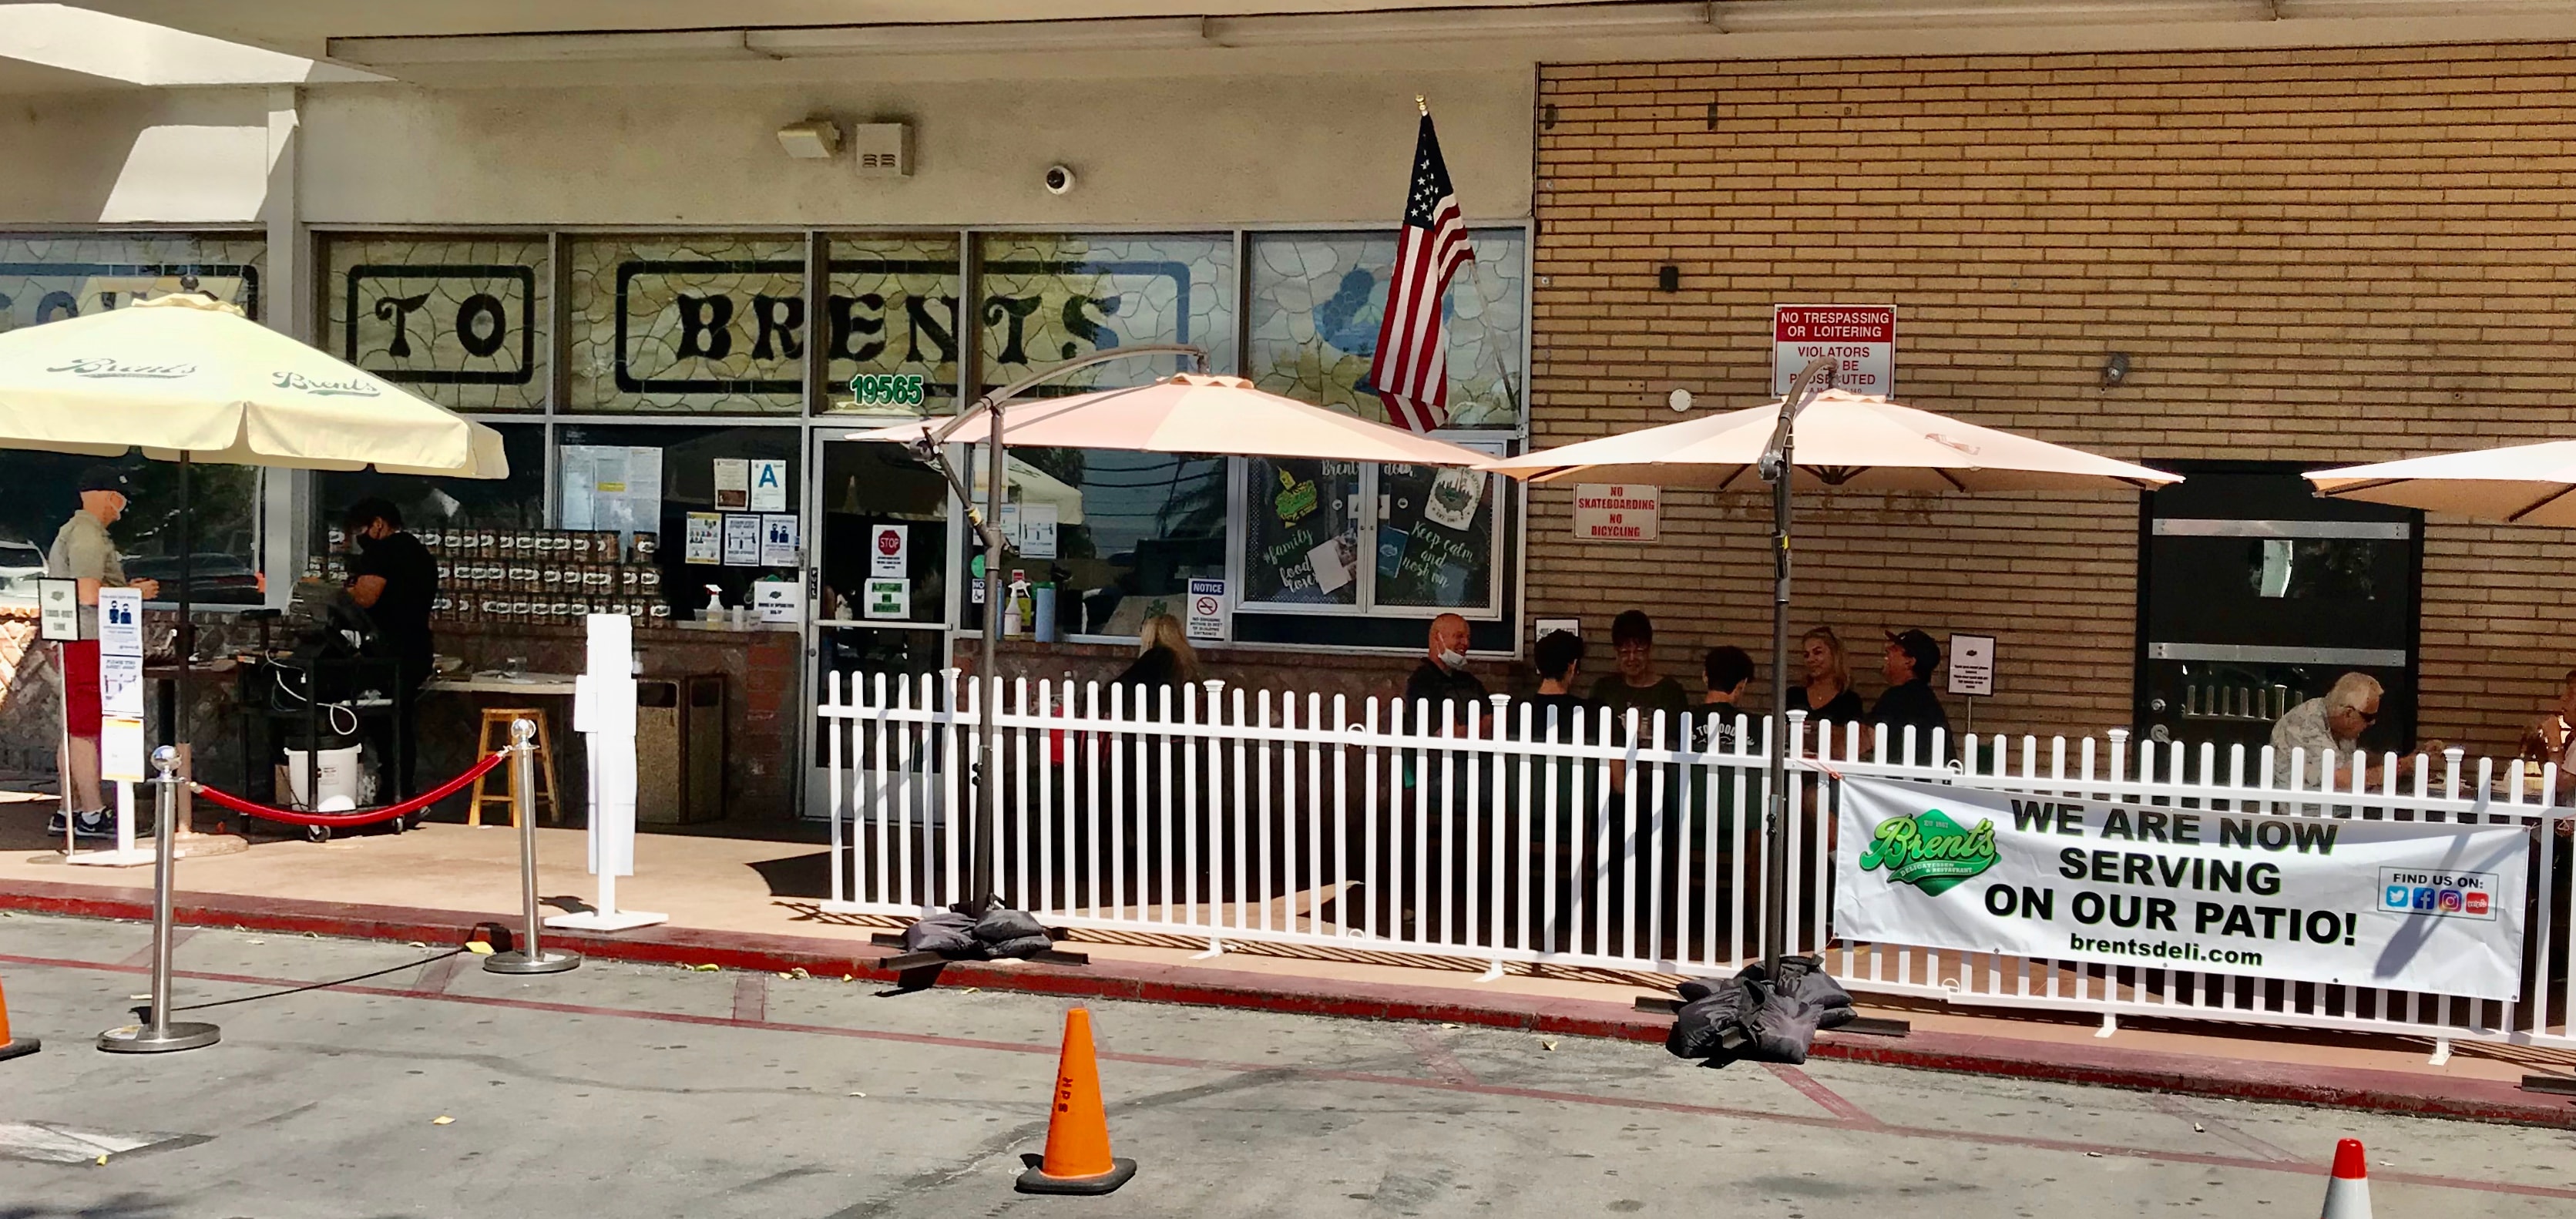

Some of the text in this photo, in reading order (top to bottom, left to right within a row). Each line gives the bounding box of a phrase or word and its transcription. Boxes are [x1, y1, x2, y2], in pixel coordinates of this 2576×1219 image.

[1781, 312, 1889, 324] NO TRESPASSING
[375, 293, 1121, 364] TO BRENTS
[1787, 326, 1882, 337] OR LOITERING
[1798, 346, 1870, 358] VIOLATORS
[1842, 360, 1859, 371] BE
[850, 374, 923, 405] 19565
[758, 463, 778, 488] A
[1610, 486, 1623, 497] NO
[1578, 498, 1655, 510] SKATEBOARDING
[1609, 513, 1622, 524] NO
[1591, 526, 1641, 537] BICYCLING
[880, 537, 900, 549] STOP
[1263, 529, 1313, 566] #family
[1411, 520, 1473, 563] Keep calm
[1420, 550, 1447, 569] and
[1193, 583, 1223, 593] NOTICE
[2010, 798, 2339, 855] WE ARE NOW
[1859, 813, 1997, 871] Brent's
[2058, 847, 2281, 896] SERVING
[2393, 873, 2484, 889] FIND US ON:
[1984, 883, 2358, 946] ON OUR PATIO!
[2070, 933, 2263, 965] brentsdeli.com
